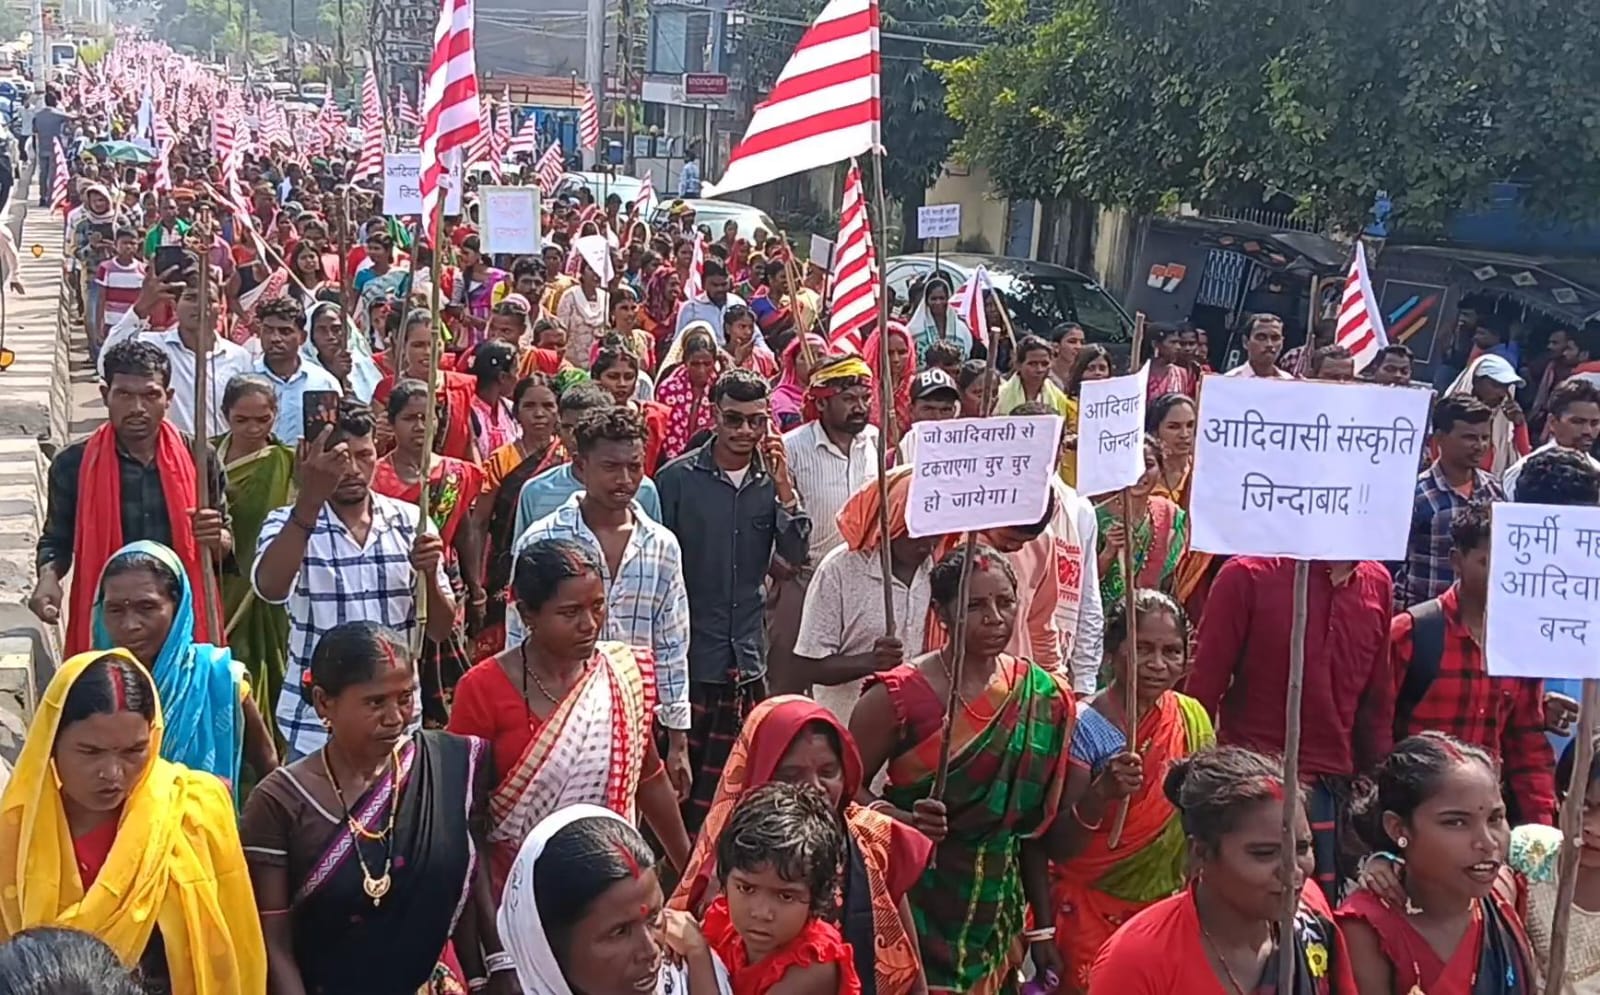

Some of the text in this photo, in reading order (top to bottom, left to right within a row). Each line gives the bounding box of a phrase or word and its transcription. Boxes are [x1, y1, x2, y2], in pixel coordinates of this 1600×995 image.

[923, 421, 1036, 446] जो आदिवासी से
[1204, 409, 1418, 465] आदिवासी संस्कृति
[921, 454, 1031, 479] टकराएगा चुर चुर
[923, 490, 941, 513] हो
[1241, 472, 1352, 515] जिन्दाबाद
[1506, 514, 1561, 566] कुर्मी
[1538, 616, 1591, 646] बन्द
